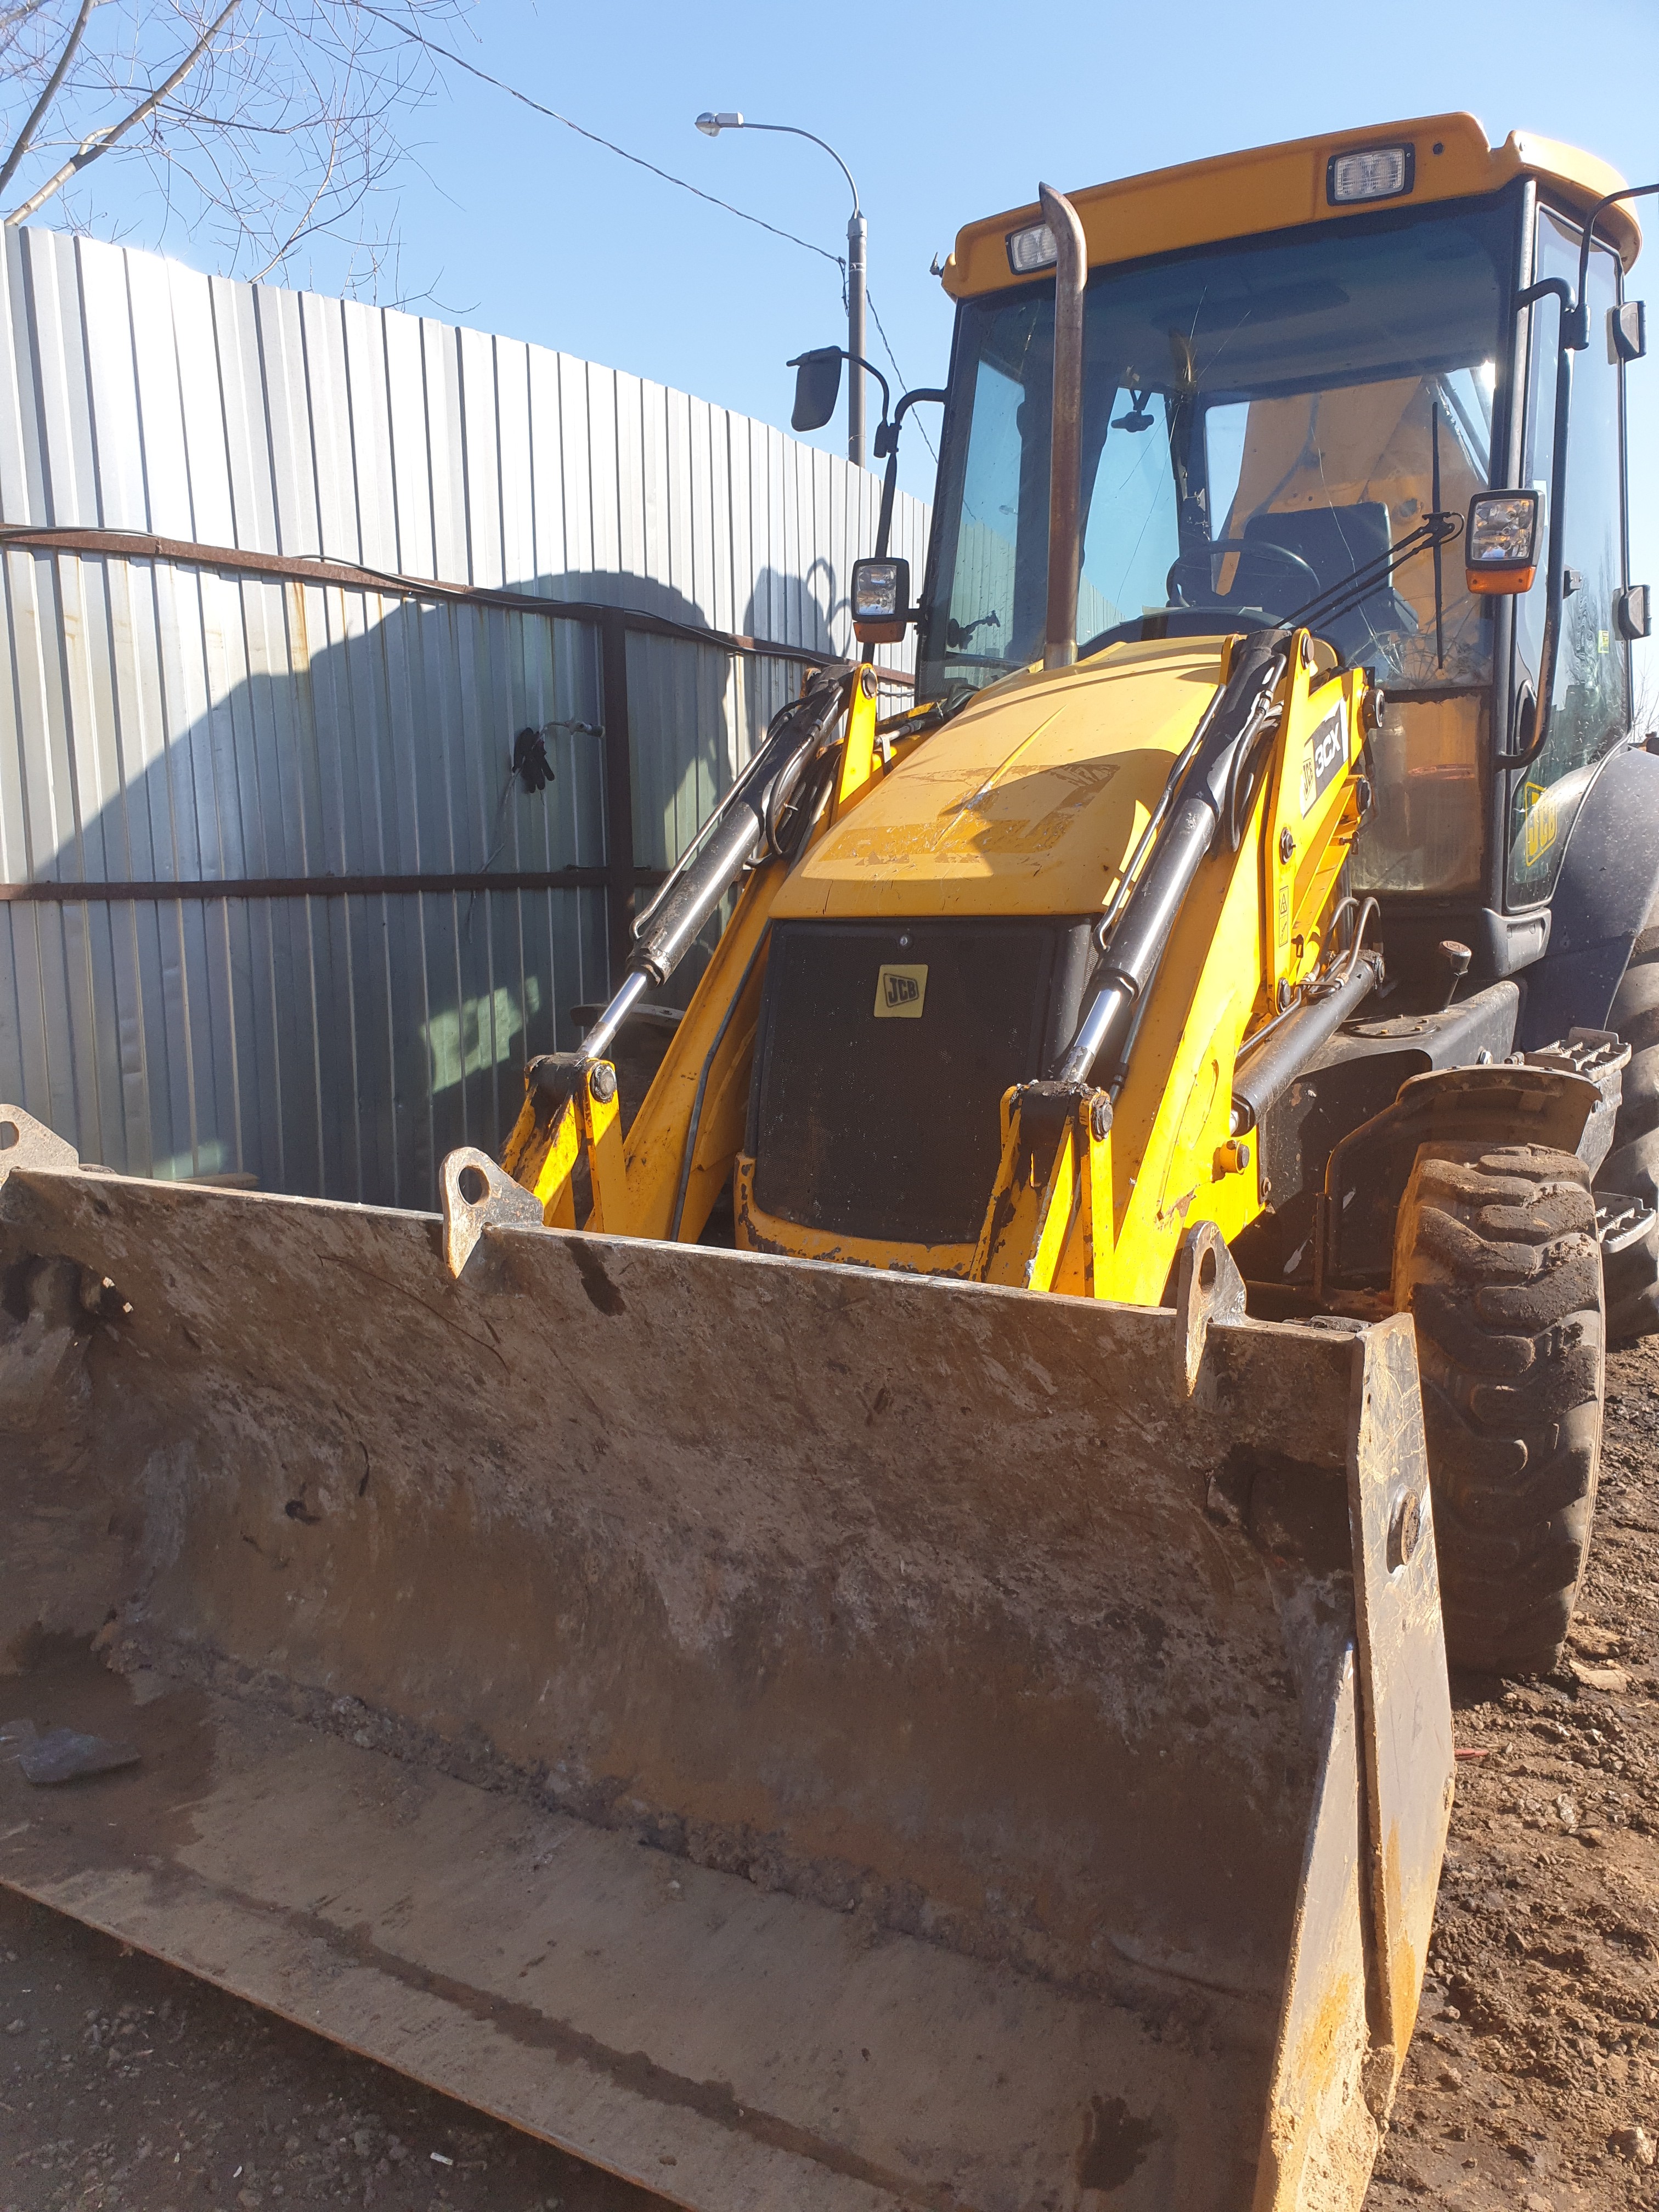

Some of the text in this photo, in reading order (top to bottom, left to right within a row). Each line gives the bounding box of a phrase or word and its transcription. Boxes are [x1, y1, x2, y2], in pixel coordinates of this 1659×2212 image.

[1304, 722, 1341, 794] JCB 3CX
[1528, 792, 1555, 856] JCB
[888, 978, 916, 1003] JCB
